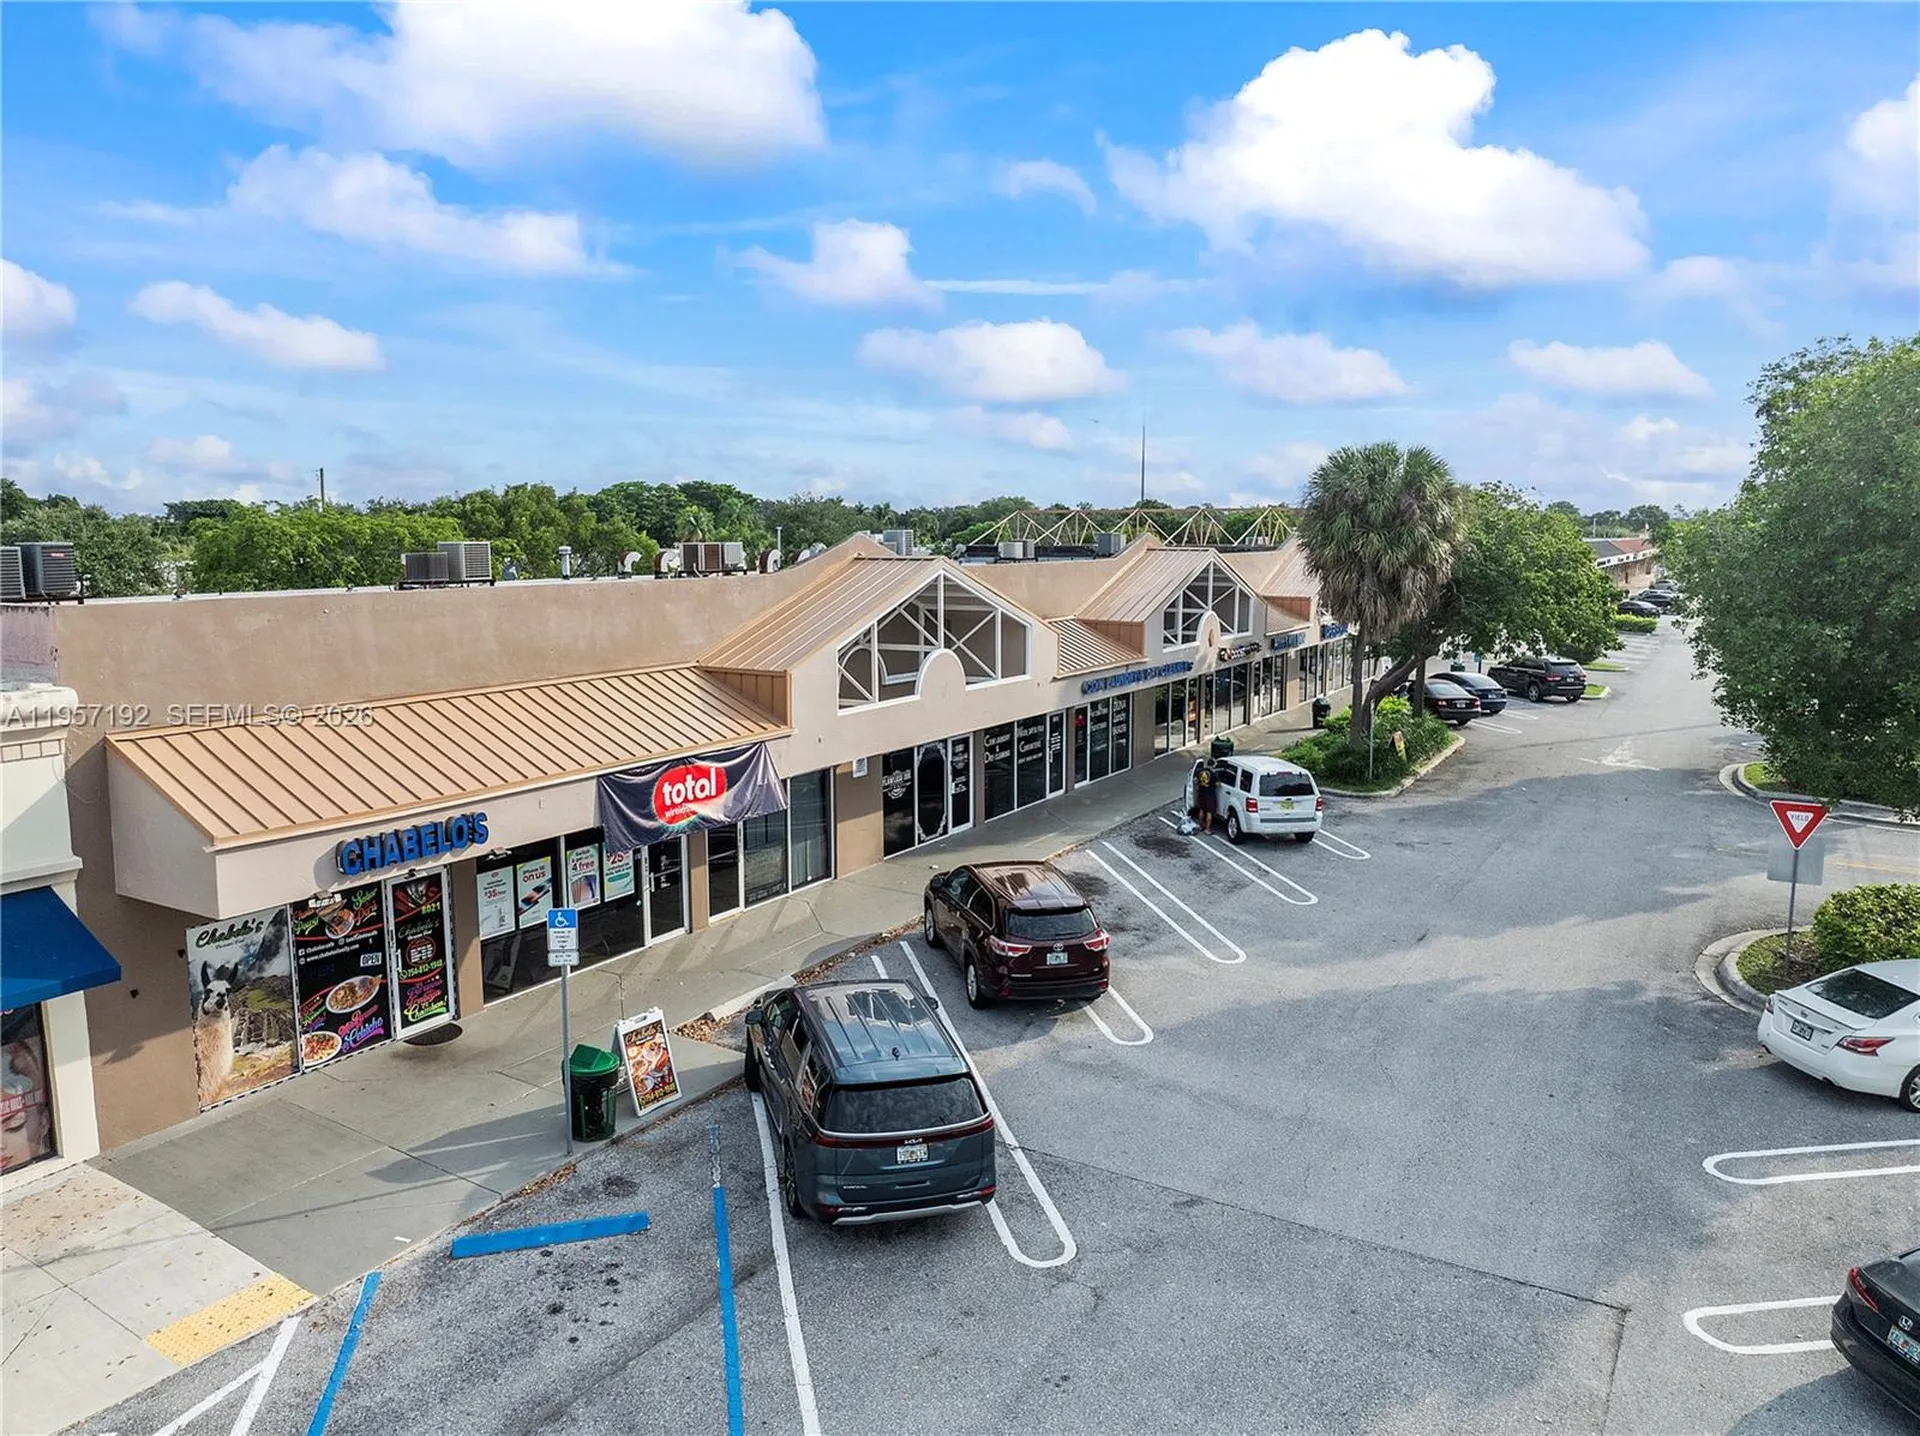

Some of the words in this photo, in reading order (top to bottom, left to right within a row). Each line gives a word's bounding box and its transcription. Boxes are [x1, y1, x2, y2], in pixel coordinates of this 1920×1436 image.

[663, 767, 716, 806] total
[340, 811, 489, 876] CHABELO'S
[523, 874, 535, 883] on
[535, 871, 547, 880] us
[362, 953, 381, 966] OPEN
